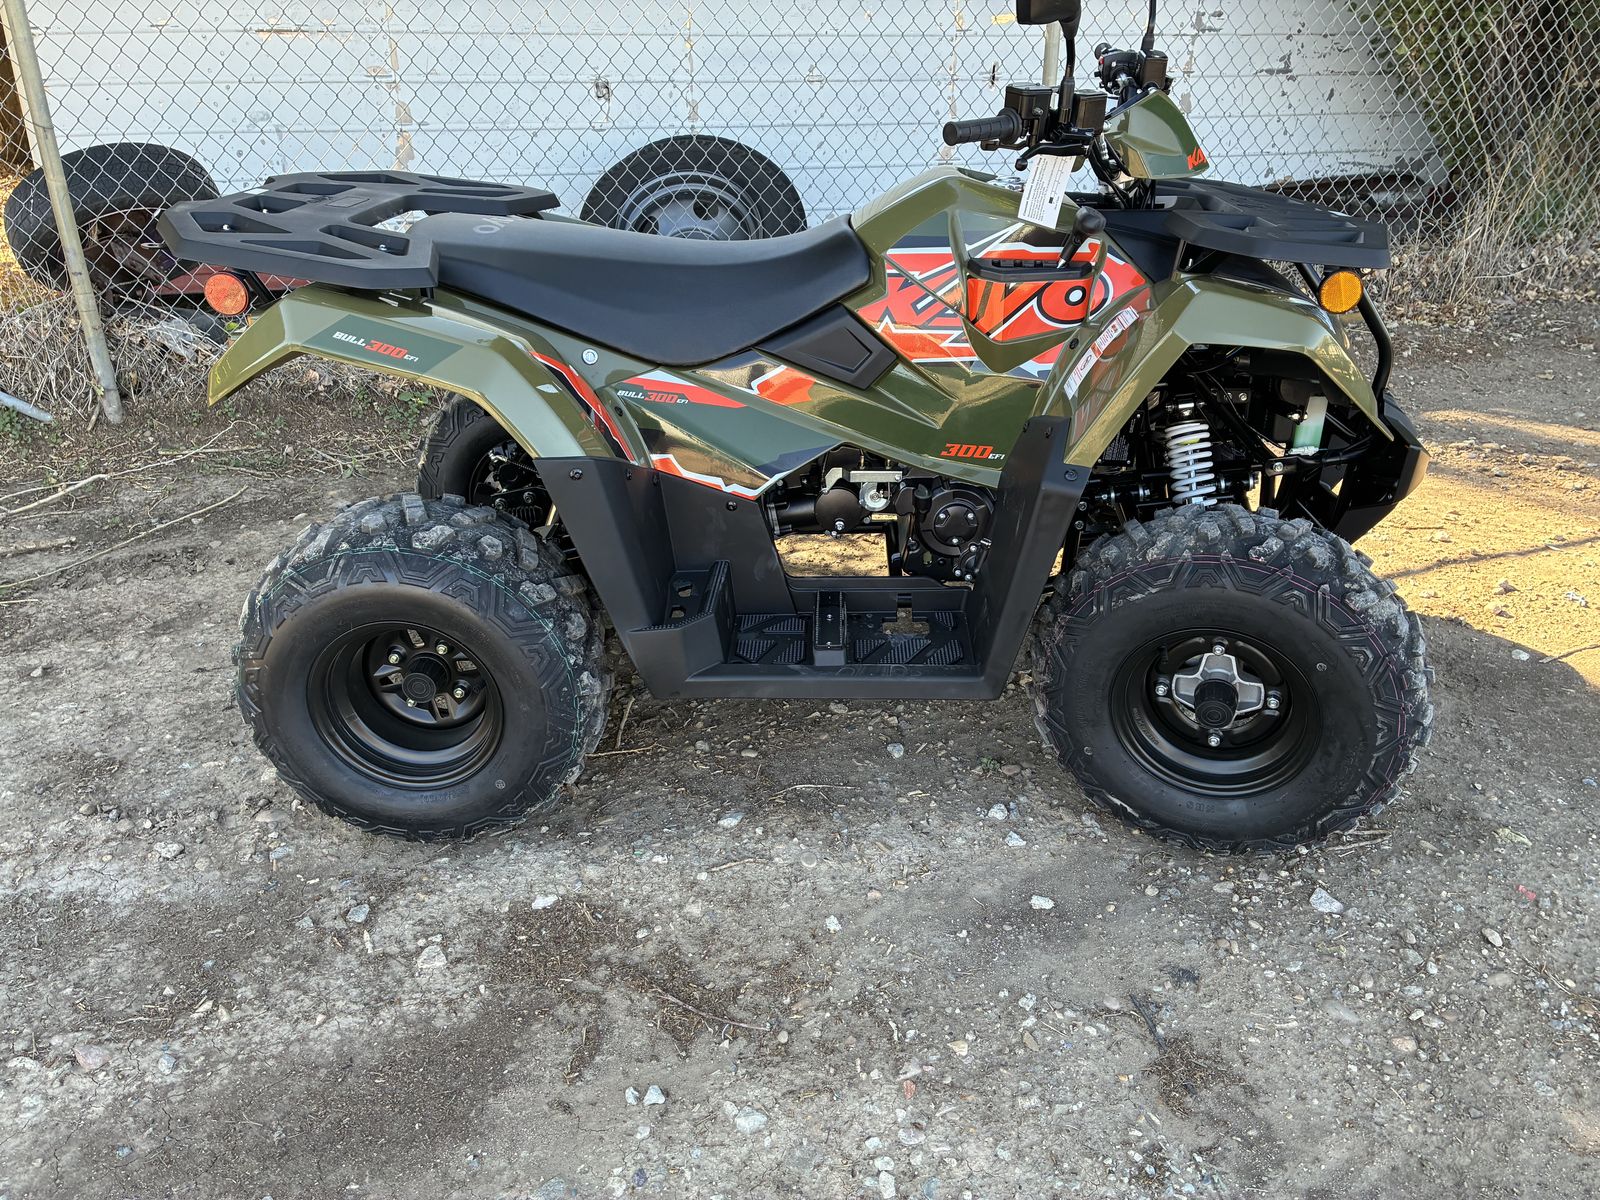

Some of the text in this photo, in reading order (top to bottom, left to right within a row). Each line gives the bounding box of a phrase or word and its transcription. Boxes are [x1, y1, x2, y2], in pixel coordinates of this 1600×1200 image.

[332, 331, 366, 347] BULL
[365, 340, 408, 359] 300
[616, 389, 645, 399] BULL
[644, 391, 679, 404] 300
[940, 443, 993, 459] 300
